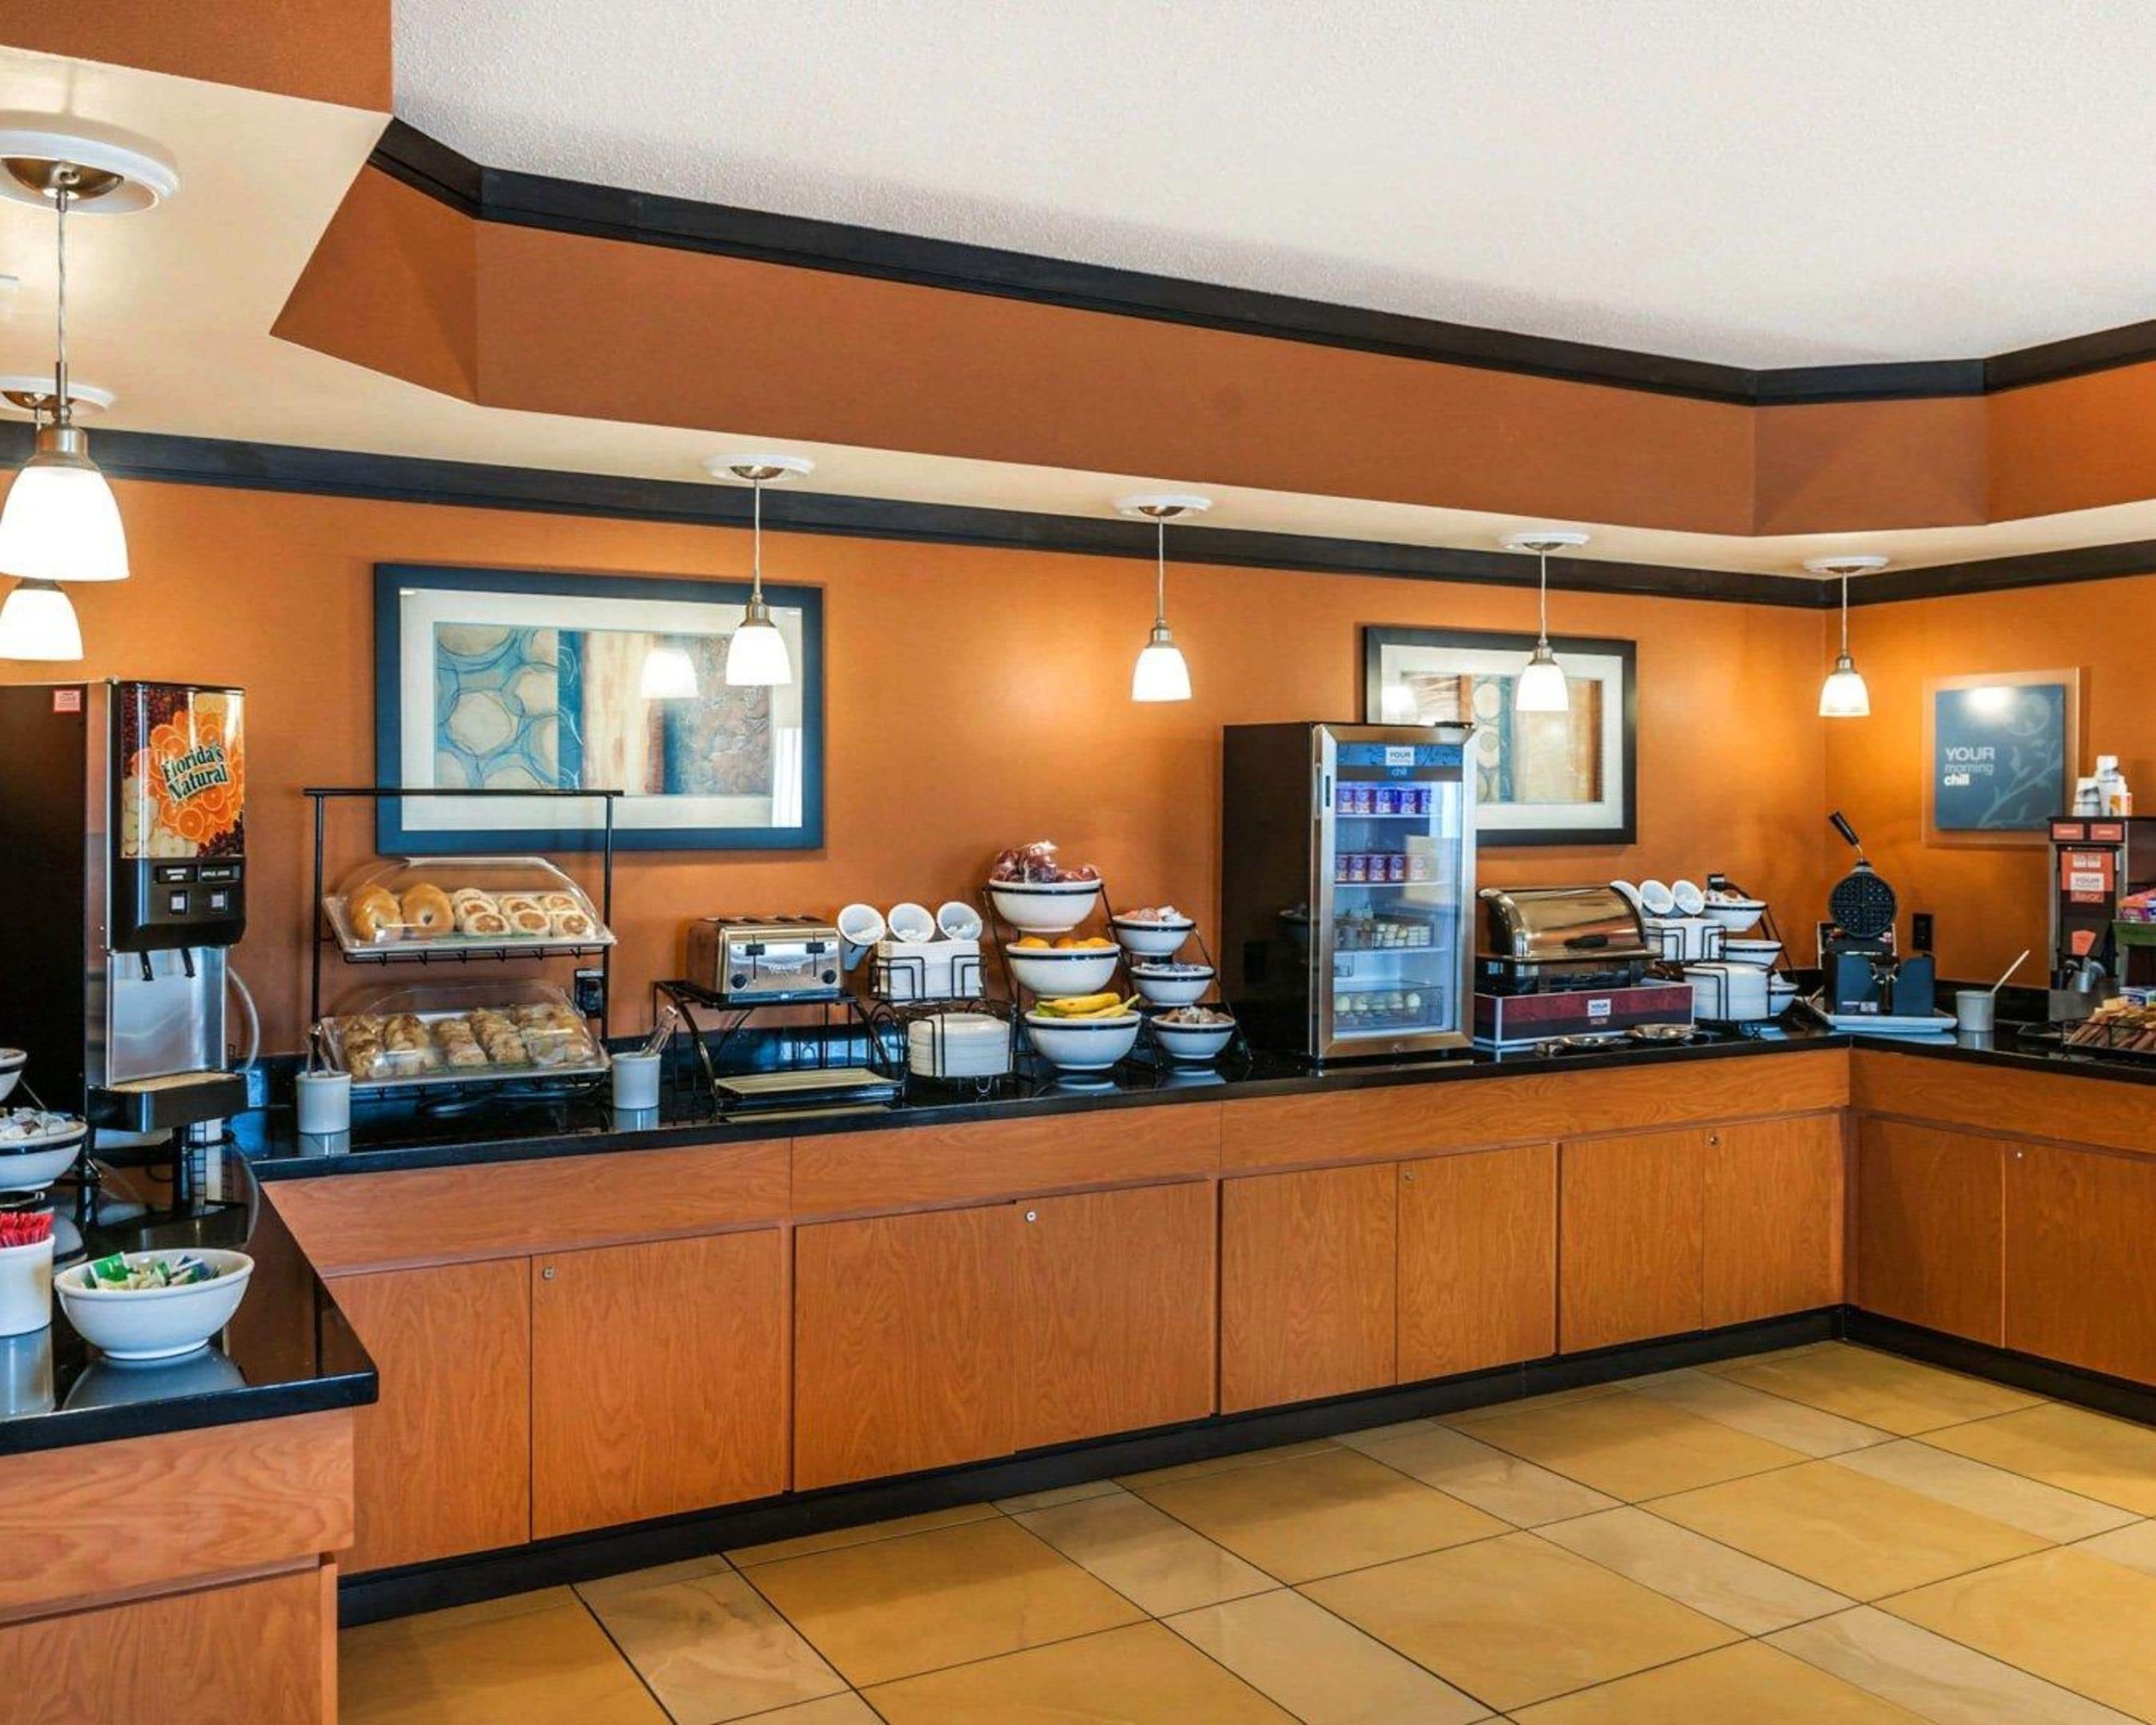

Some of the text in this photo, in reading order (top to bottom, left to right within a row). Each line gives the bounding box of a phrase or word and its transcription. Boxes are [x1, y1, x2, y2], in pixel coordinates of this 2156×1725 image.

[161, 745, 224, 783] Florida's
[1945, 746, 1995, 761] YOUR
[168, 764, 228, 801] Natural
[1943, 773, 1970, 786] chill
